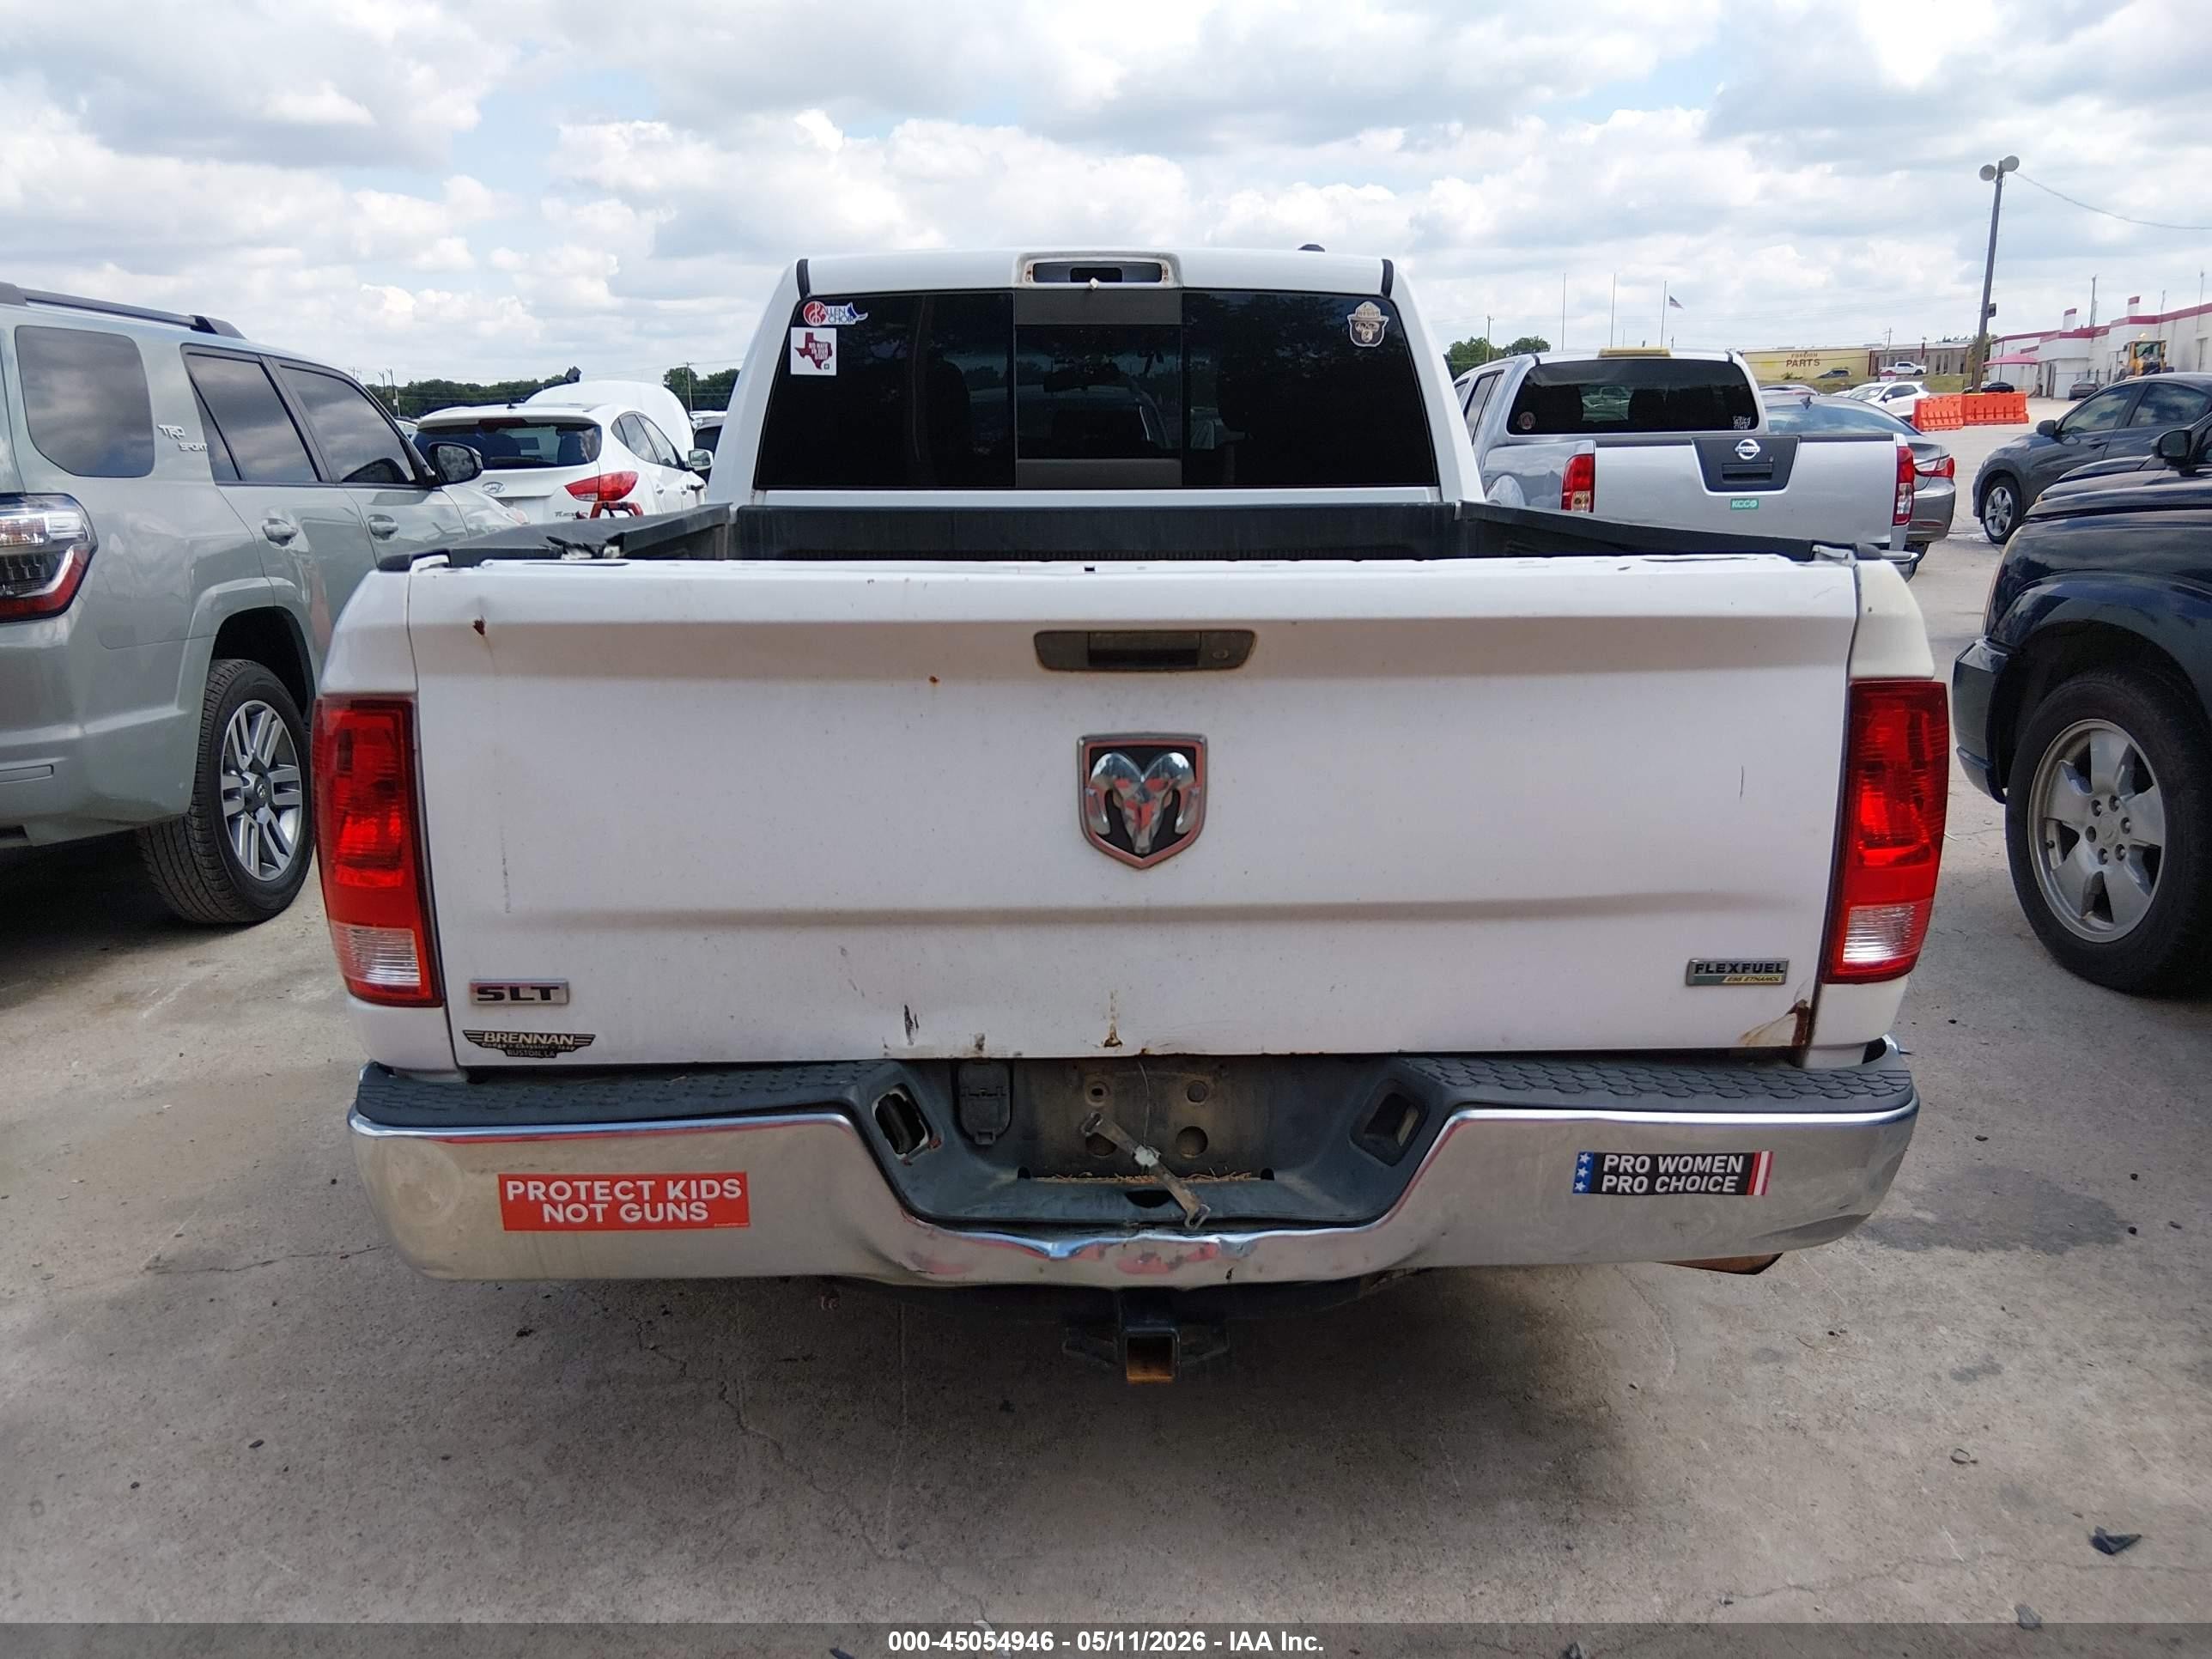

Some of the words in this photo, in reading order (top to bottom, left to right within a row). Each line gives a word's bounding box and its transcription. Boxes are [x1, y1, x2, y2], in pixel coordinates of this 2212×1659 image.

[820, 307, 846, 315] ALLEN
[829, 314, 854, 324] CHOIR
[1786, 358, 1820, 368] PARTS
[157, 424, 185, 440] TRD
[477, 986, 559, 1002] SLT
[483, 1031, 574, 1045] BRENNAN
[1603, 1154, 1650, 1173] PRO
[1658, 1155, 1744, 1174] WOMEN
[506, 1180, 656, 1201] PROTECT
[666, 1178, 742, 1200] KIDS
[1601, 1175, 1649, 1193] PRO
[1655, 1175, 1738, 1194] CHOICE
[543, 1203, 609, 1223] NOT
[619, 1202, 708, 1223] GUNS
